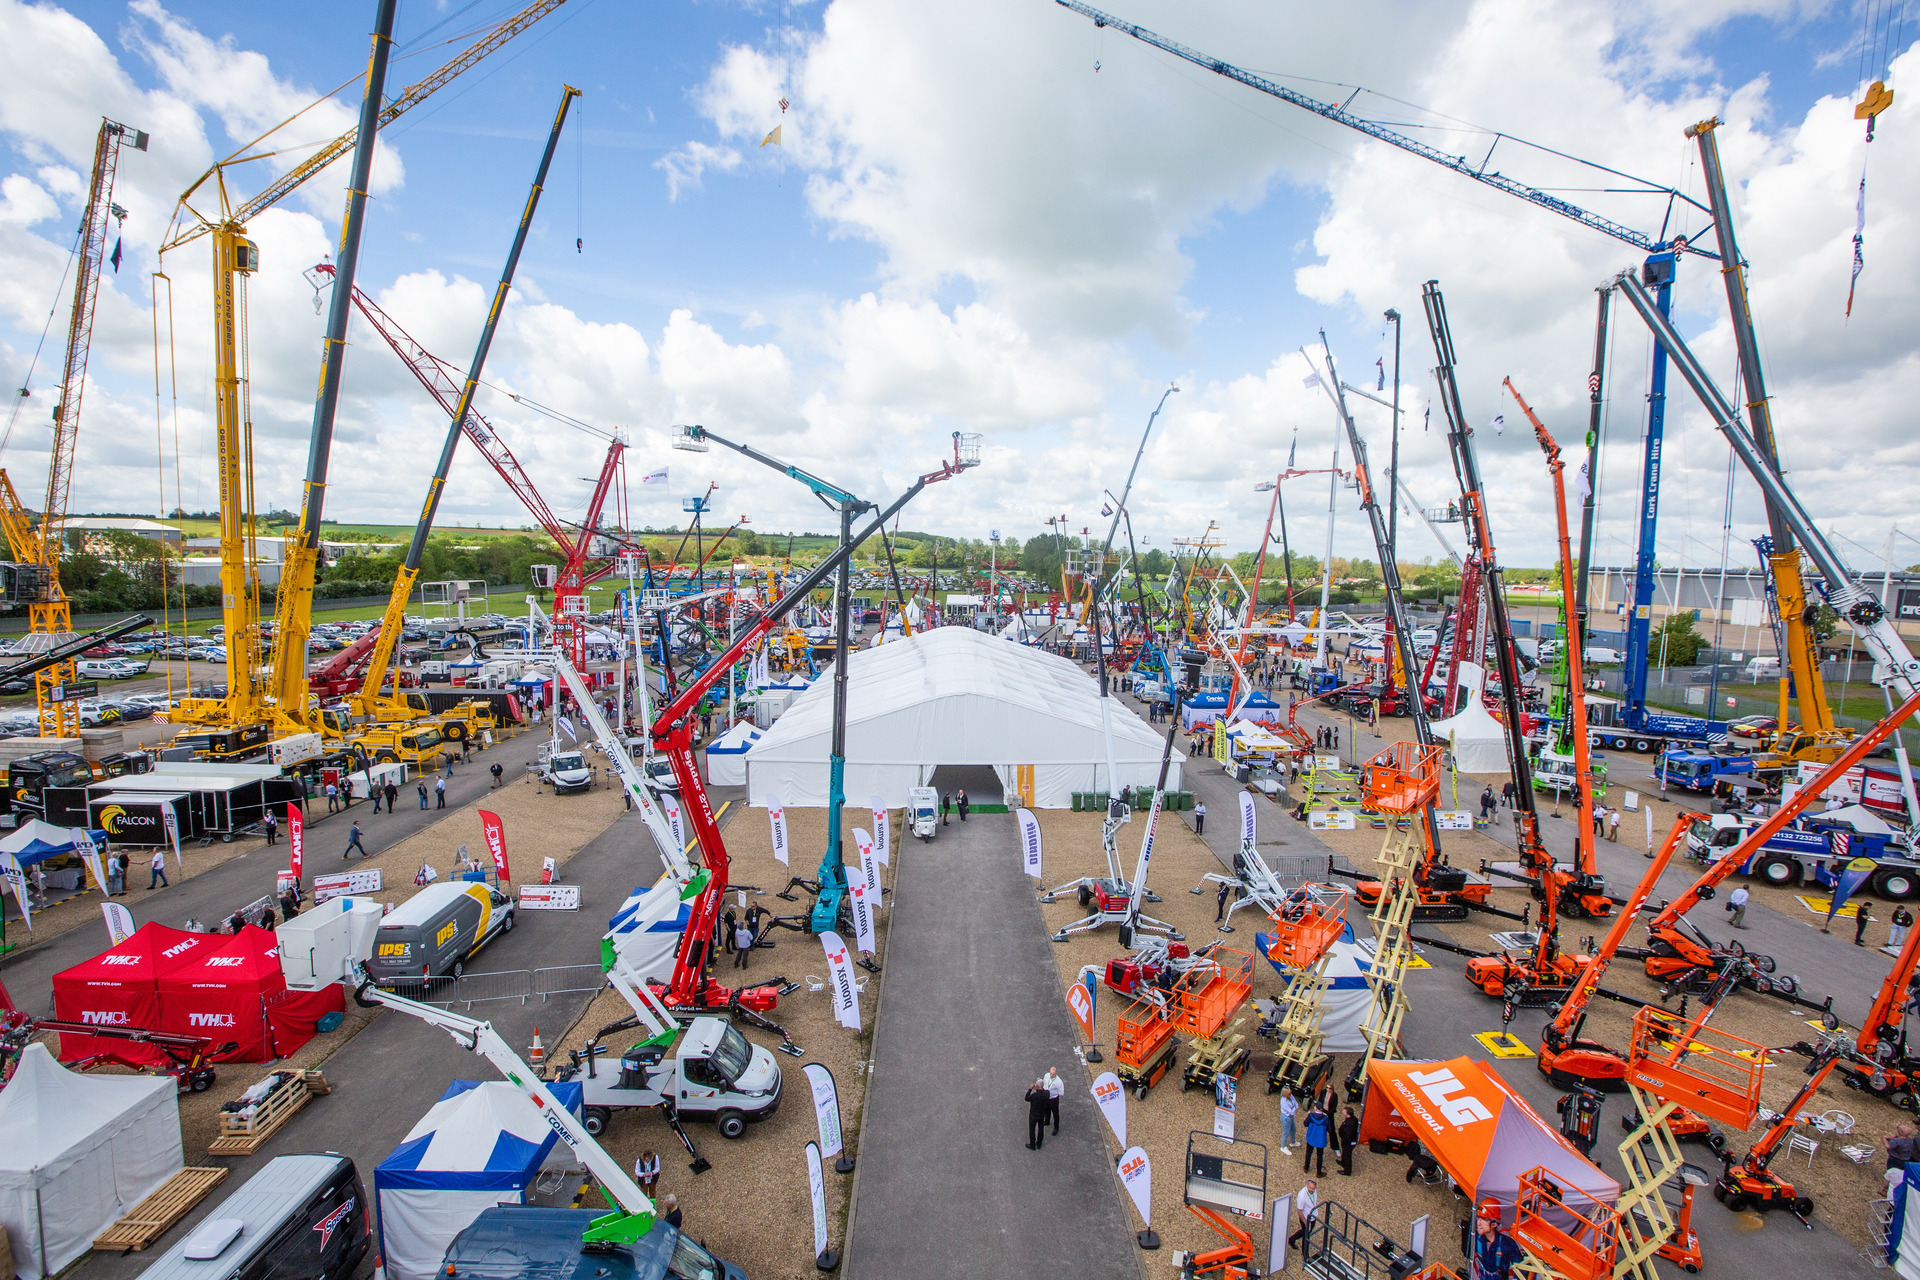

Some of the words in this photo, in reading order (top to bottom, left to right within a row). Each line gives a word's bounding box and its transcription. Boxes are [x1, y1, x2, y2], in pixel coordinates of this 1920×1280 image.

[465, 419, 489, 444] OLFF
[1651, 438, 1660, 461] Hire
[1648, 463, 1659, 492] Crane
[1647, 494, 1657, 519] Cork
[741, 629, 765, 653] PLATFORM
[607, 750, 626, 775] COMET
[684, 750, 701, 791] Spider
[698, 793, 714, 827] 27.14
[116, 816, 156, 826] FALCON
[436, 921, 454, 947] IPS
[101, 955, 127, 965] TVH
[162, 942, 190, 959] TVH
[205, 957, 229, 966] TVH
[378, 943, 405, 956] IPS
[82, 1010, 112, 1025] TVH
[189, 1013, 220, 1027] TVH
[1406, 1067, 1494, 1127] JLG
[548, 1116, 578, 1148] COMET
[325, 1196, 355, 1234] Speedy
